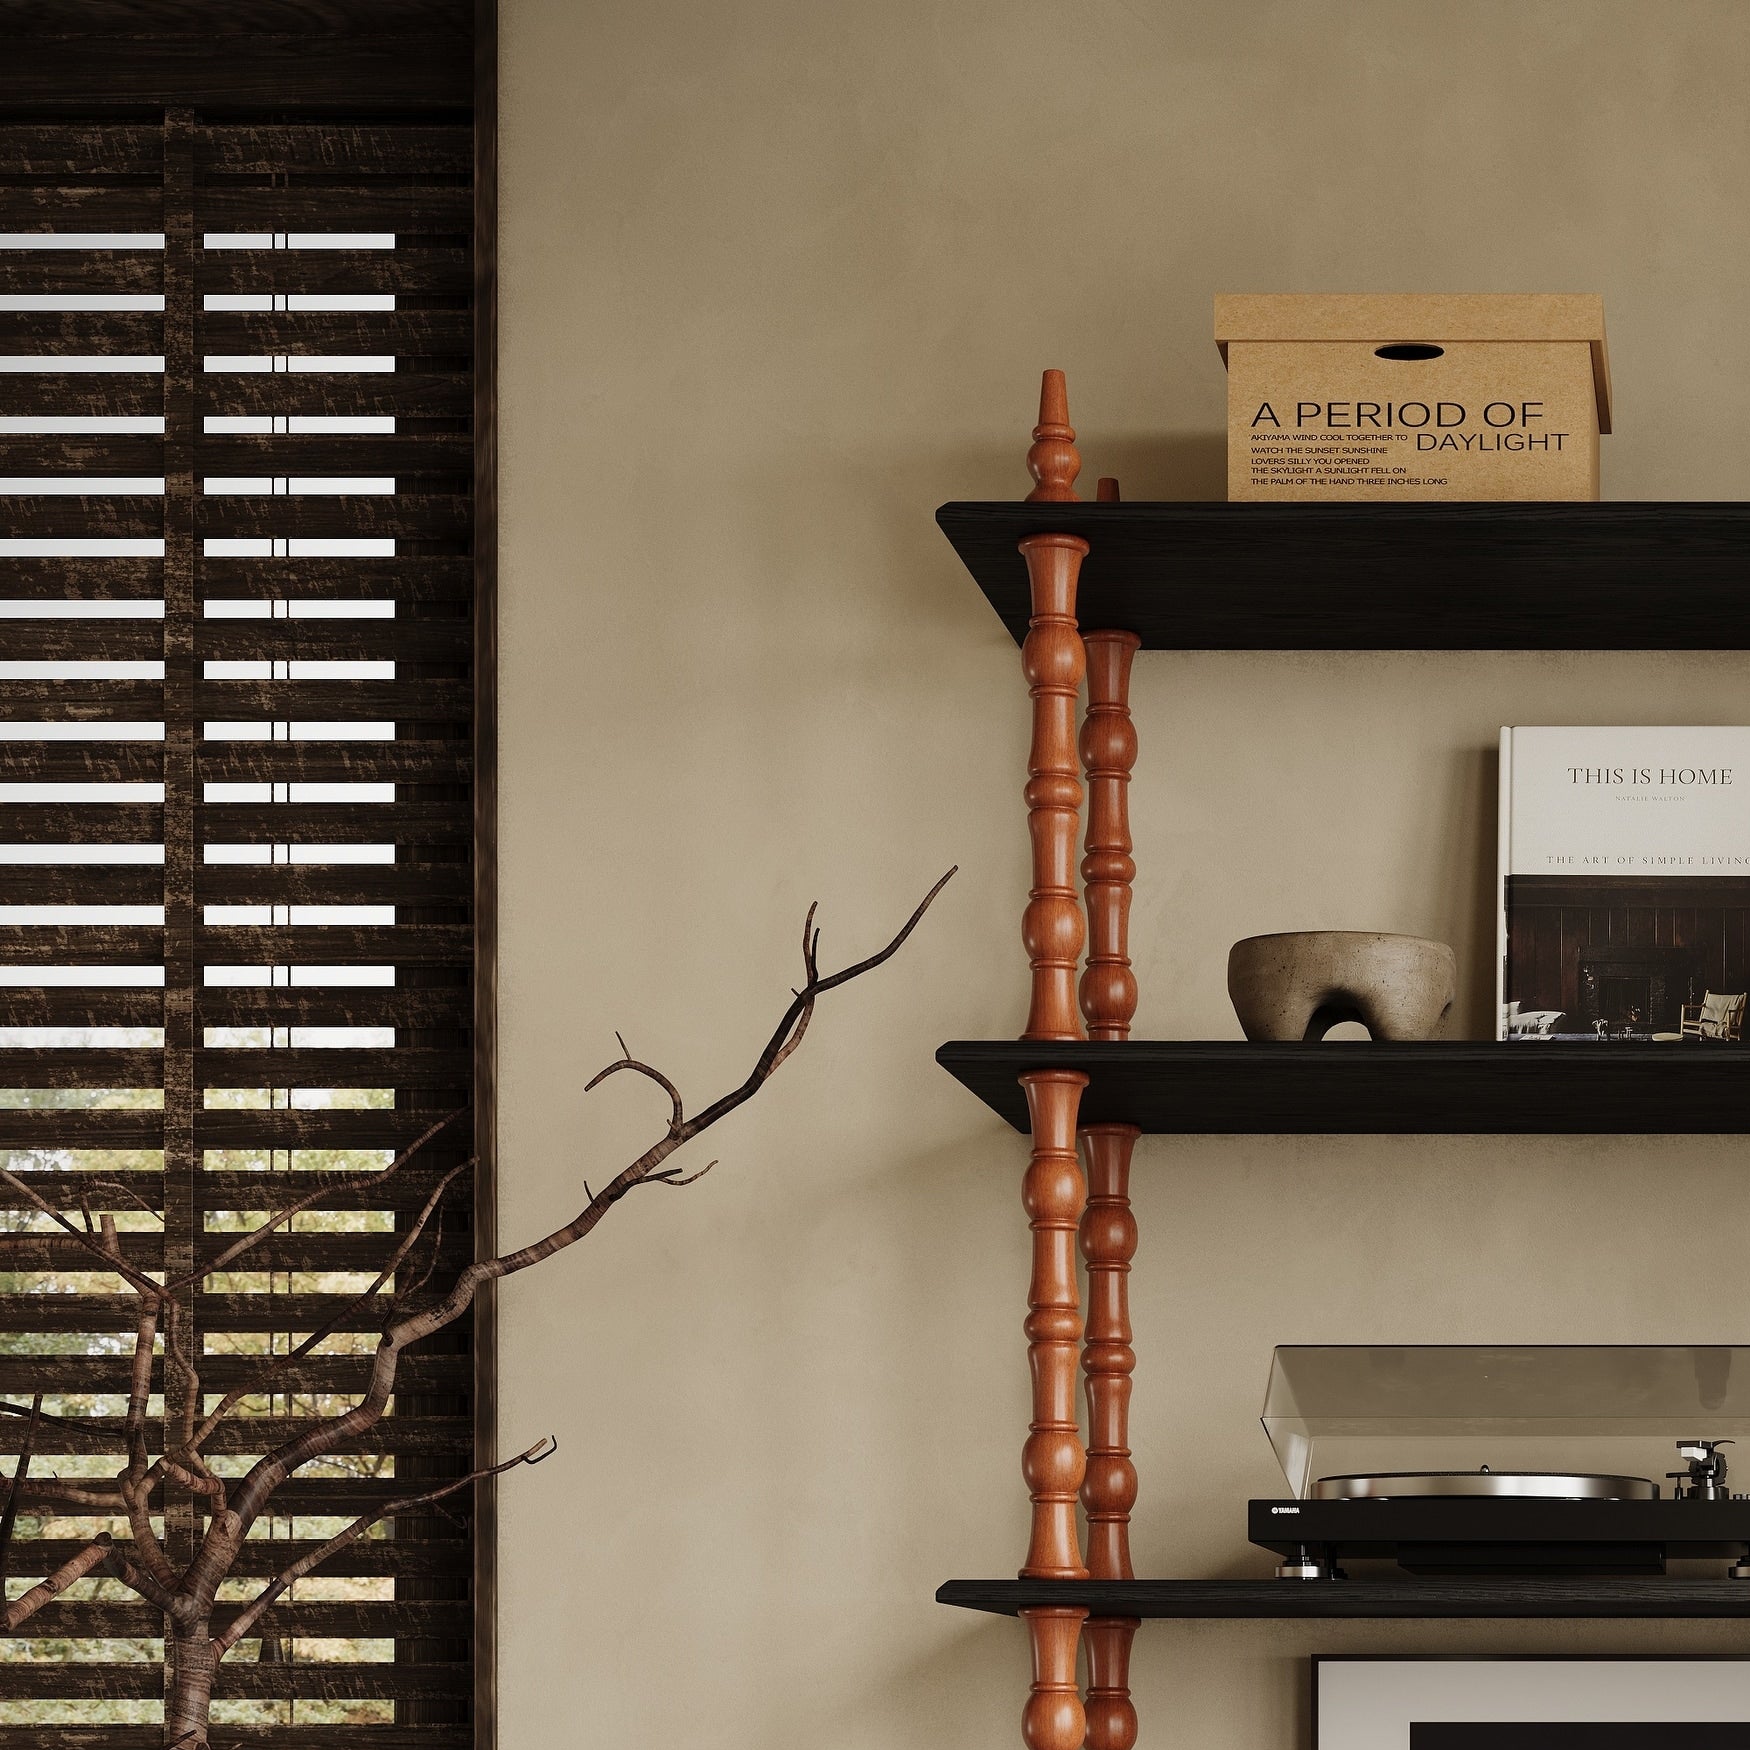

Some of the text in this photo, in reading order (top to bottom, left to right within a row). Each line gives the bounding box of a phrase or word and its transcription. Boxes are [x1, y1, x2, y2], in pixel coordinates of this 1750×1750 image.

[1250, 402, 1544, 428] A PERIOD OF
[1416, 433, 1570, 451] DAYLIGHT
[1567, 767, 1733, 785] THIS IS HOME
[1547, 856, 1575, 865] THE
[1582, 856, 1609, 865] ART
[1617, 856, 1635, 865] OF
[1642, 856, 1695, 865] SIMPLE
